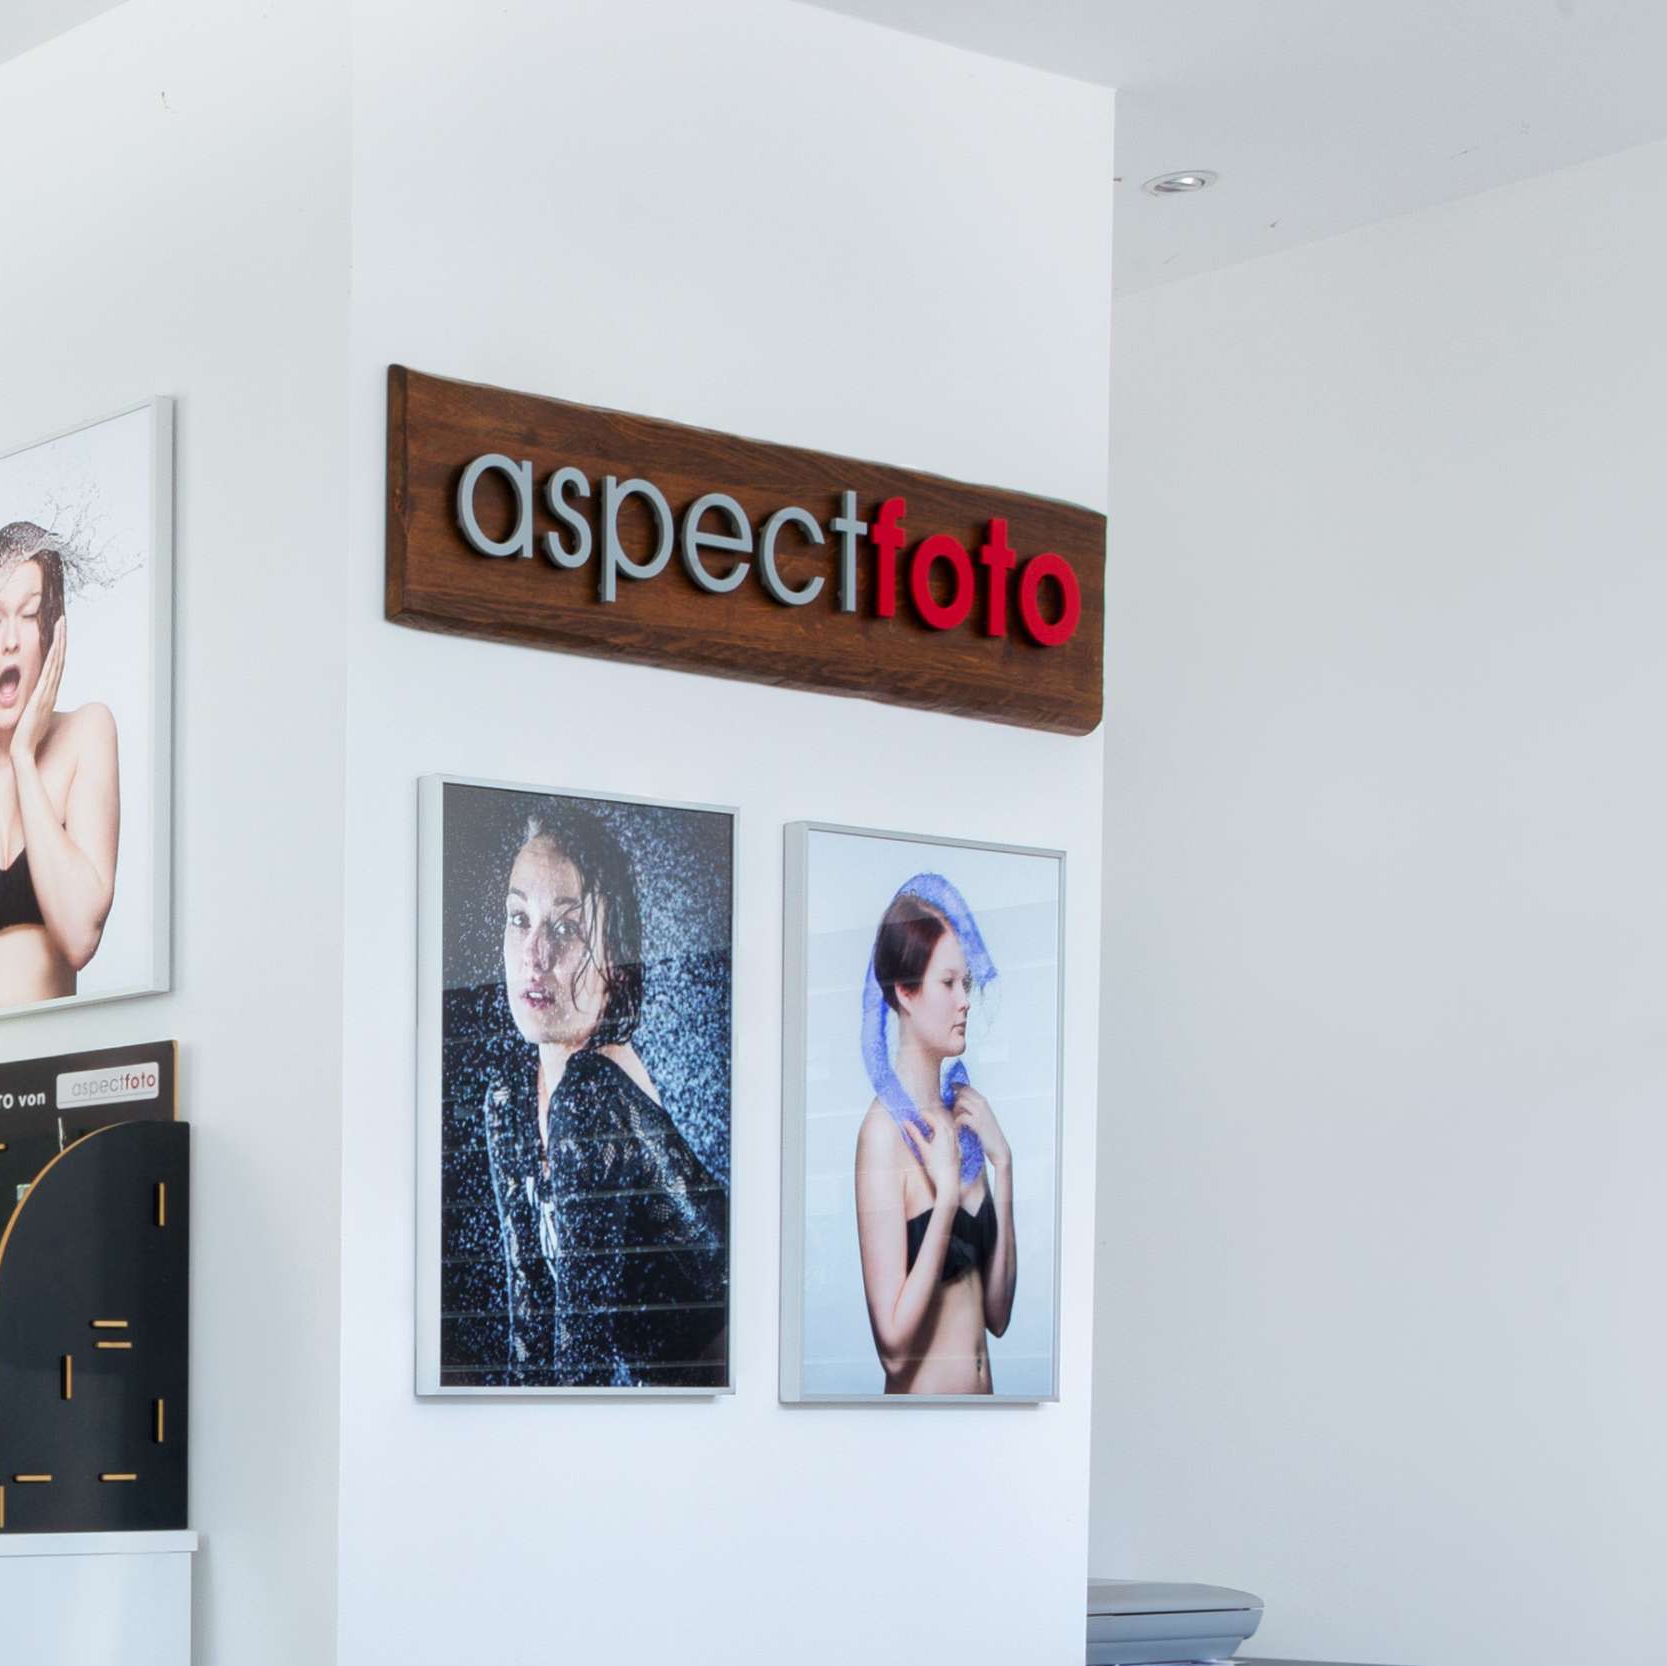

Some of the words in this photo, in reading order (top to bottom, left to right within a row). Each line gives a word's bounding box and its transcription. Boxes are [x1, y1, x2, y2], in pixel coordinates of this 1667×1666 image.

[456, 452, 1084, 648] aspectfoto
[72, 1072, 156, 1098] aspectfoto
[19, 1091, 46, 1107] von
